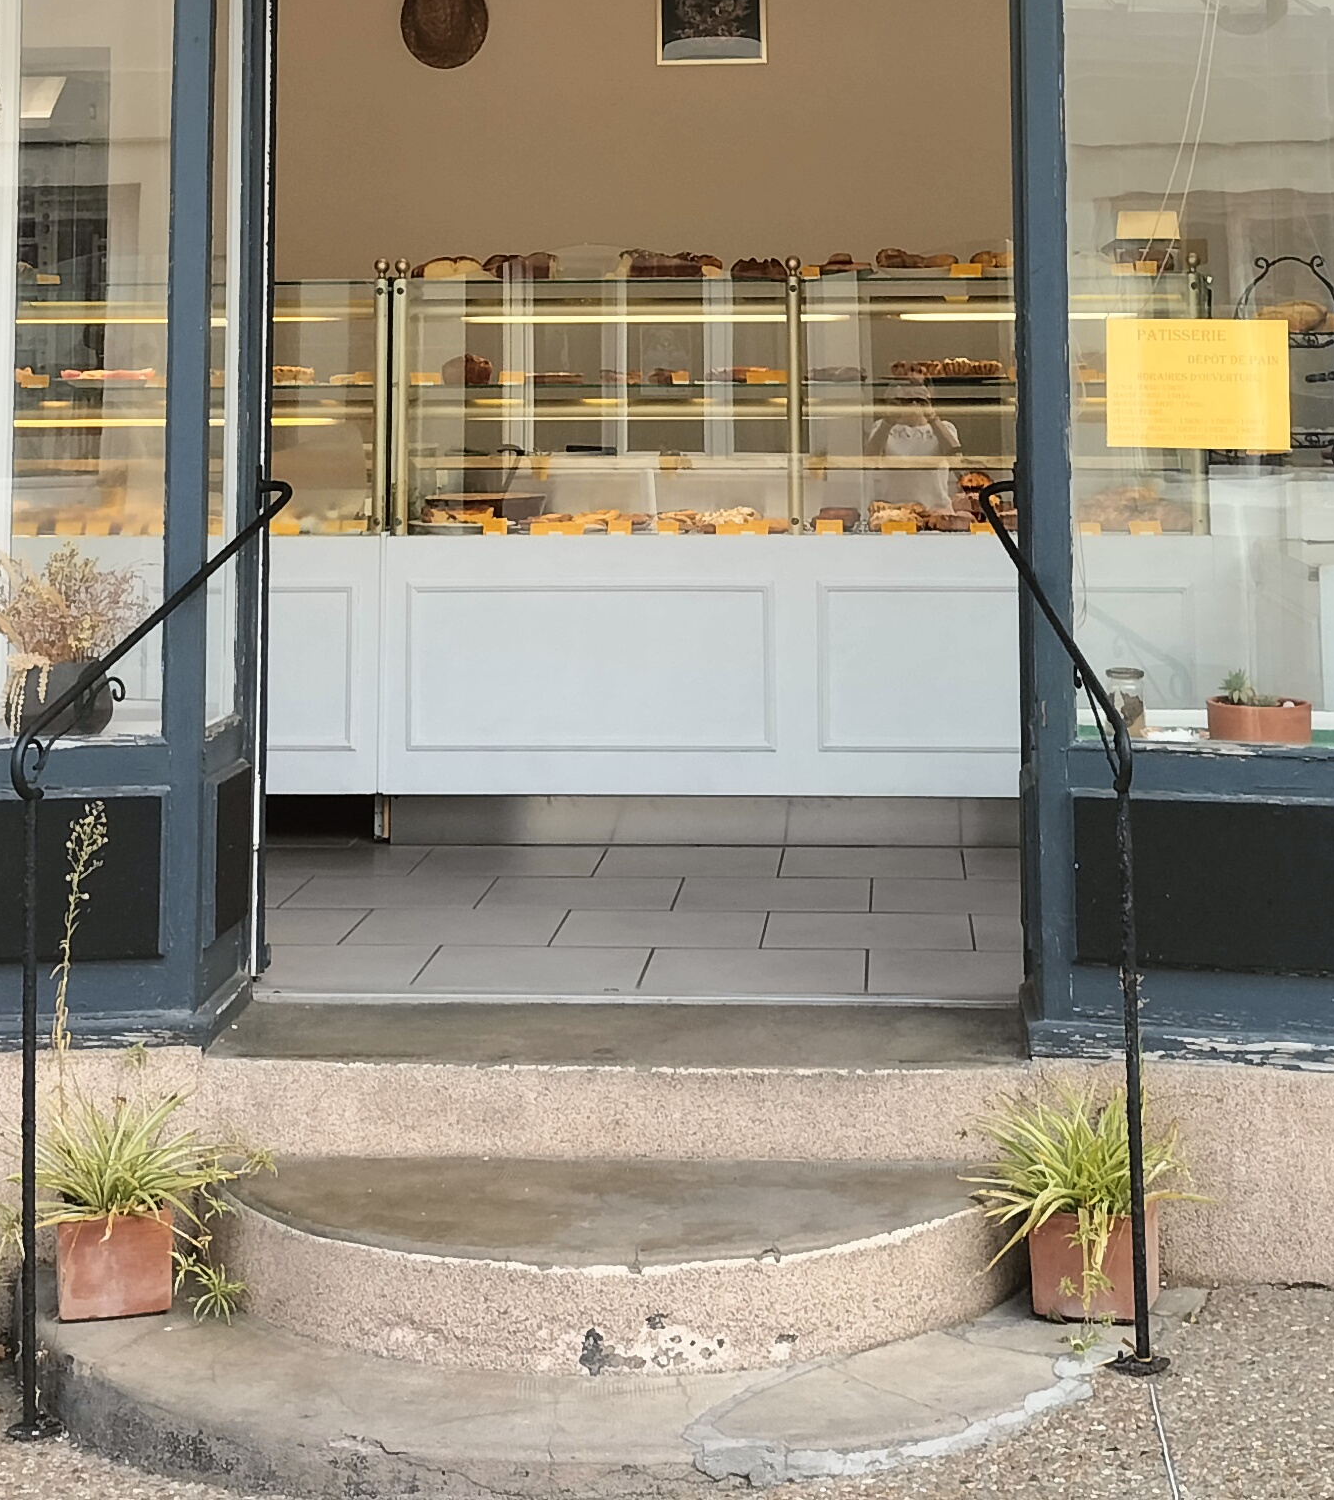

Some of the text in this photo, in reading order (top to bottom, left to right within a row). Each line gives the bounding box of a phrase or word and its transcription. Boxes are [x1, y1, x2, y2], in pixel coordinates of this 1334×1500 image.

[1136, 328, 1227, 342] PATISSERIE
[1230, 354, 1247, 366] DE
[1249, 354, 1280, 367] PAIN
